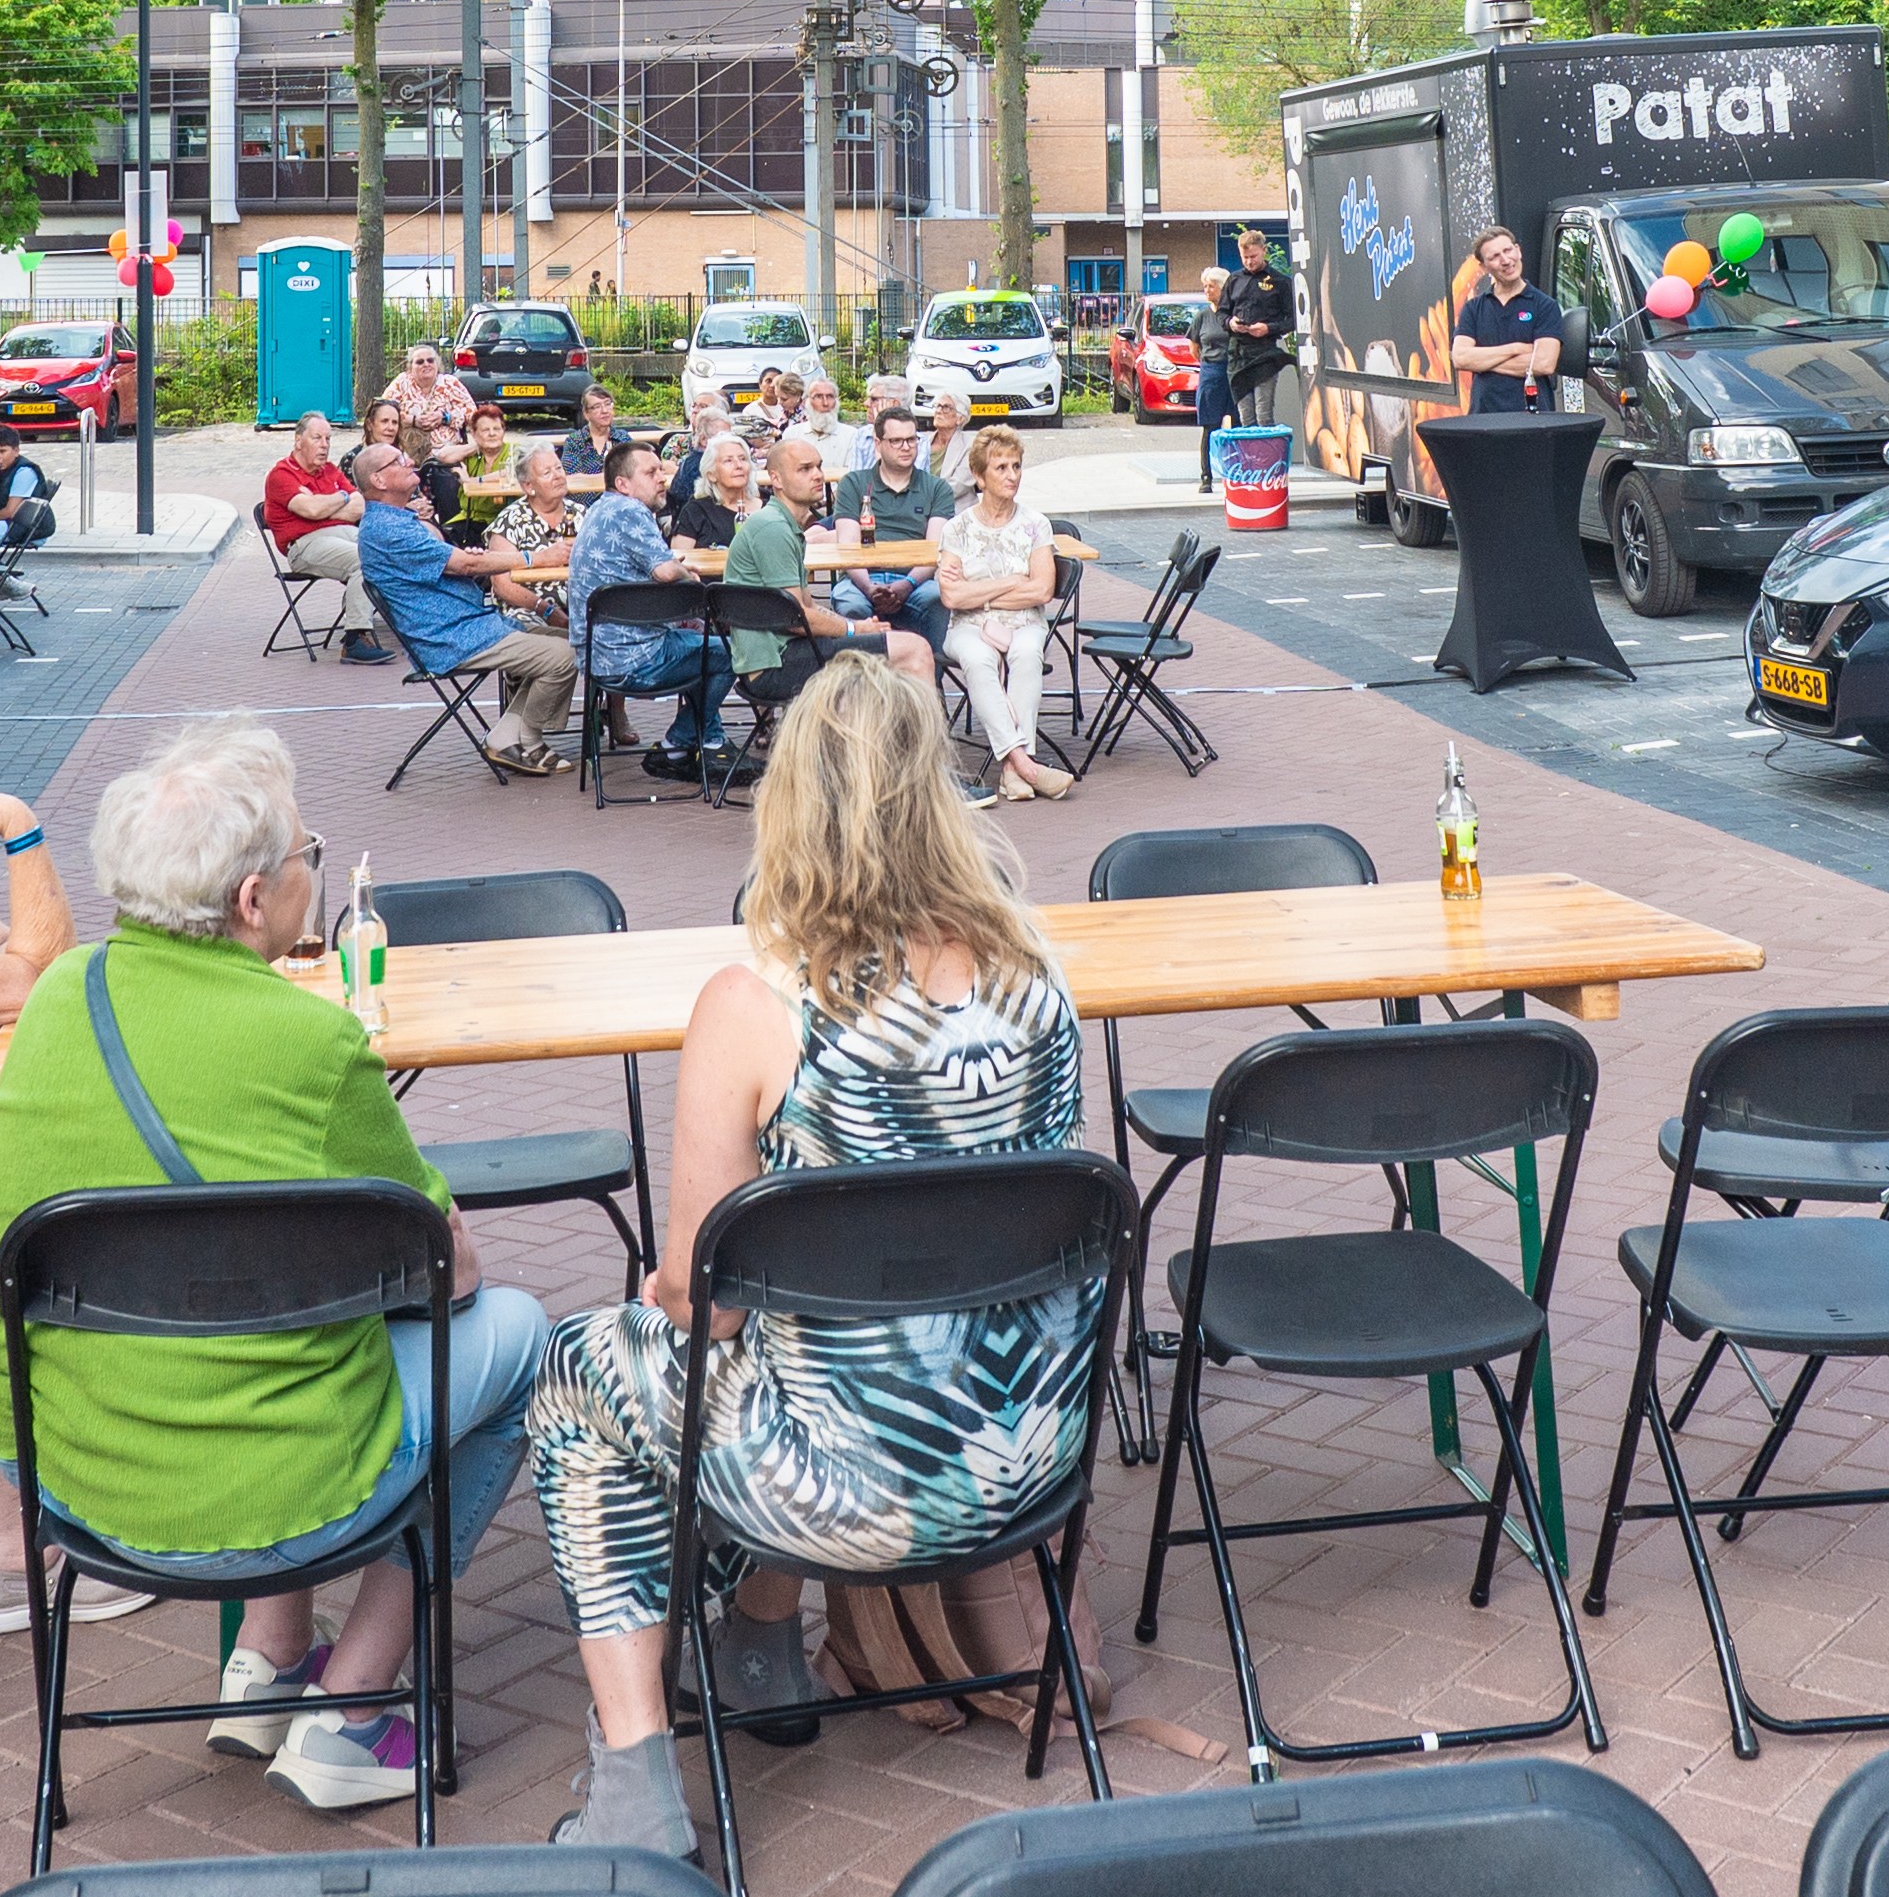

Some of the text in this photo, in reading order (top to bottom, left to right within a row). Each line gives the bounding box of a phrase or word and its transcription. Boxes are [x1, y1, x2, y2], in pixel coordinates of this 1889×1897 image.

[1323, 83, 1419, 121] Gewoon, de lekkerste.
[1593, 70, 1794, 145] Patat
[1340, 175, 1379, 254] Henk
[292, 279, 315, 287] DIXI
[1366, 216, 1415, 300] Patat
[1762, 664, 1823, 699] S-668-SB
